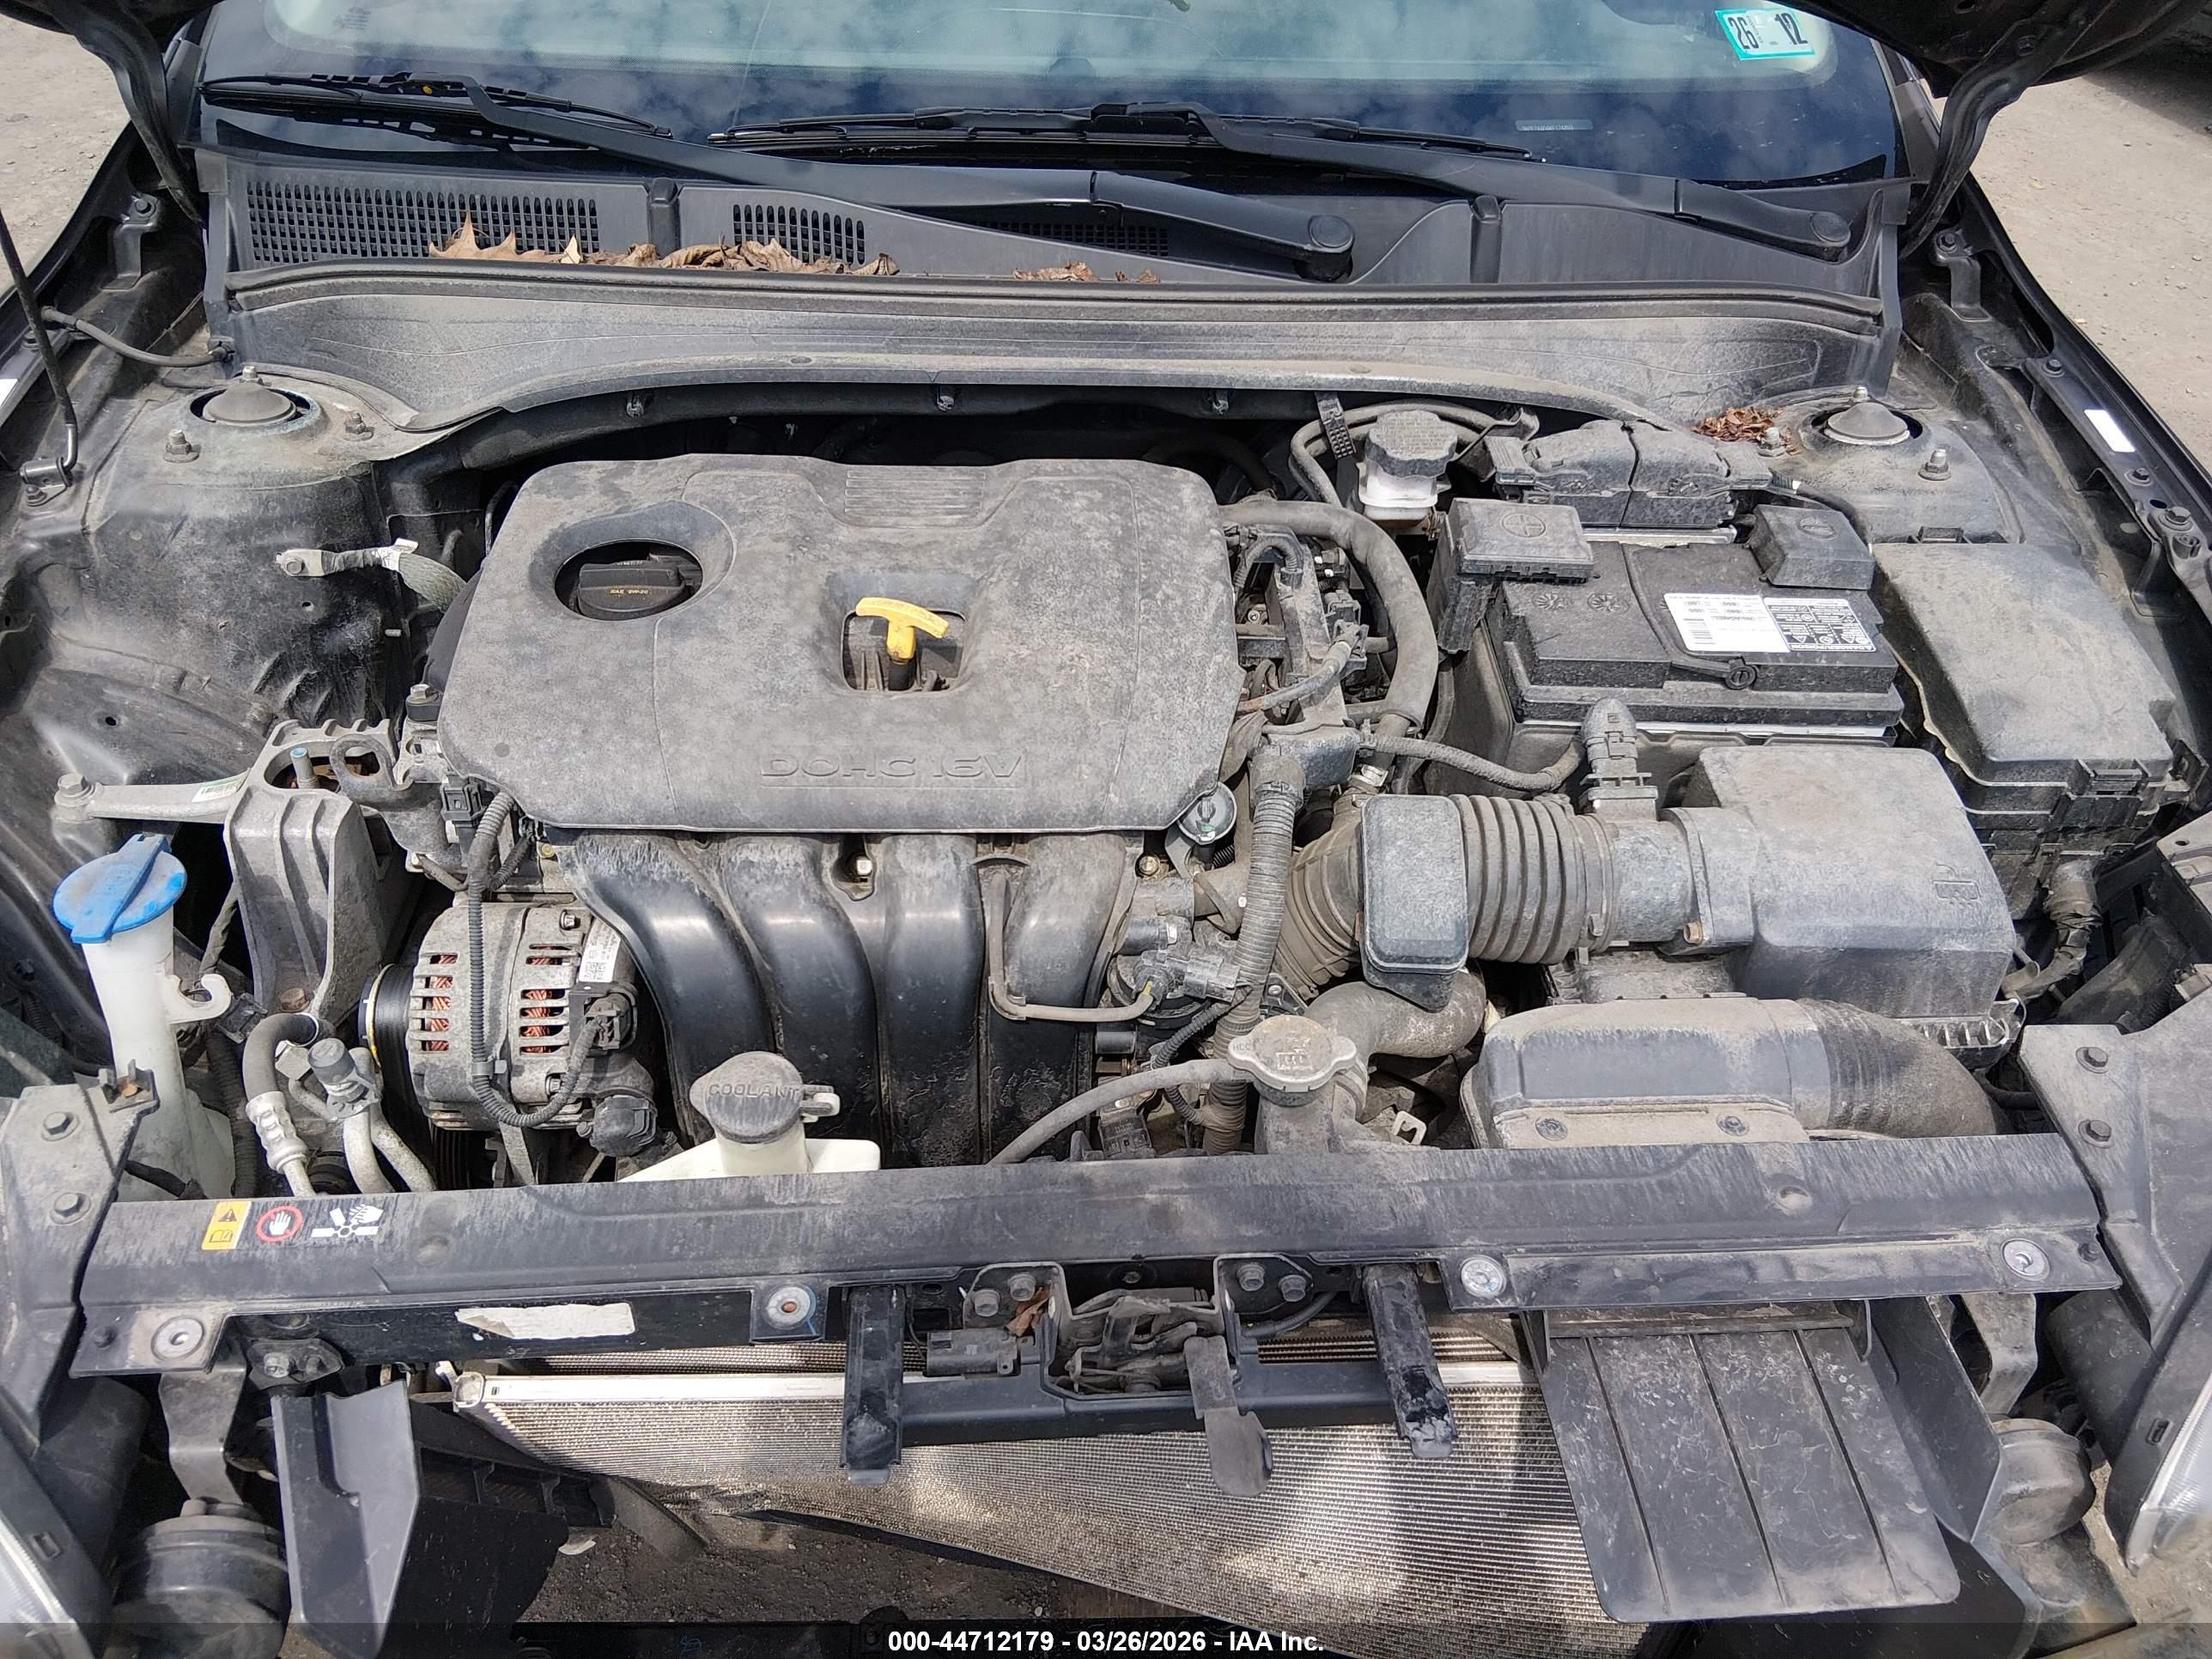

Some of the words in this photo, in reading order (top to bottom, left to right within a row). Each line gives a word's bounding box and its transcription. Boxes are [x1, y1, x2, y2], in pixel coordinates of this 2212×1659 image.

[1727, 16, 1759, 50] 26
[1774, 12, 1808, 46] 12
[761, 757, 916, 777] DOHC
[932, 756, 1022, 777] 16V
[708, 1083, 800, 1100] COOLANT
